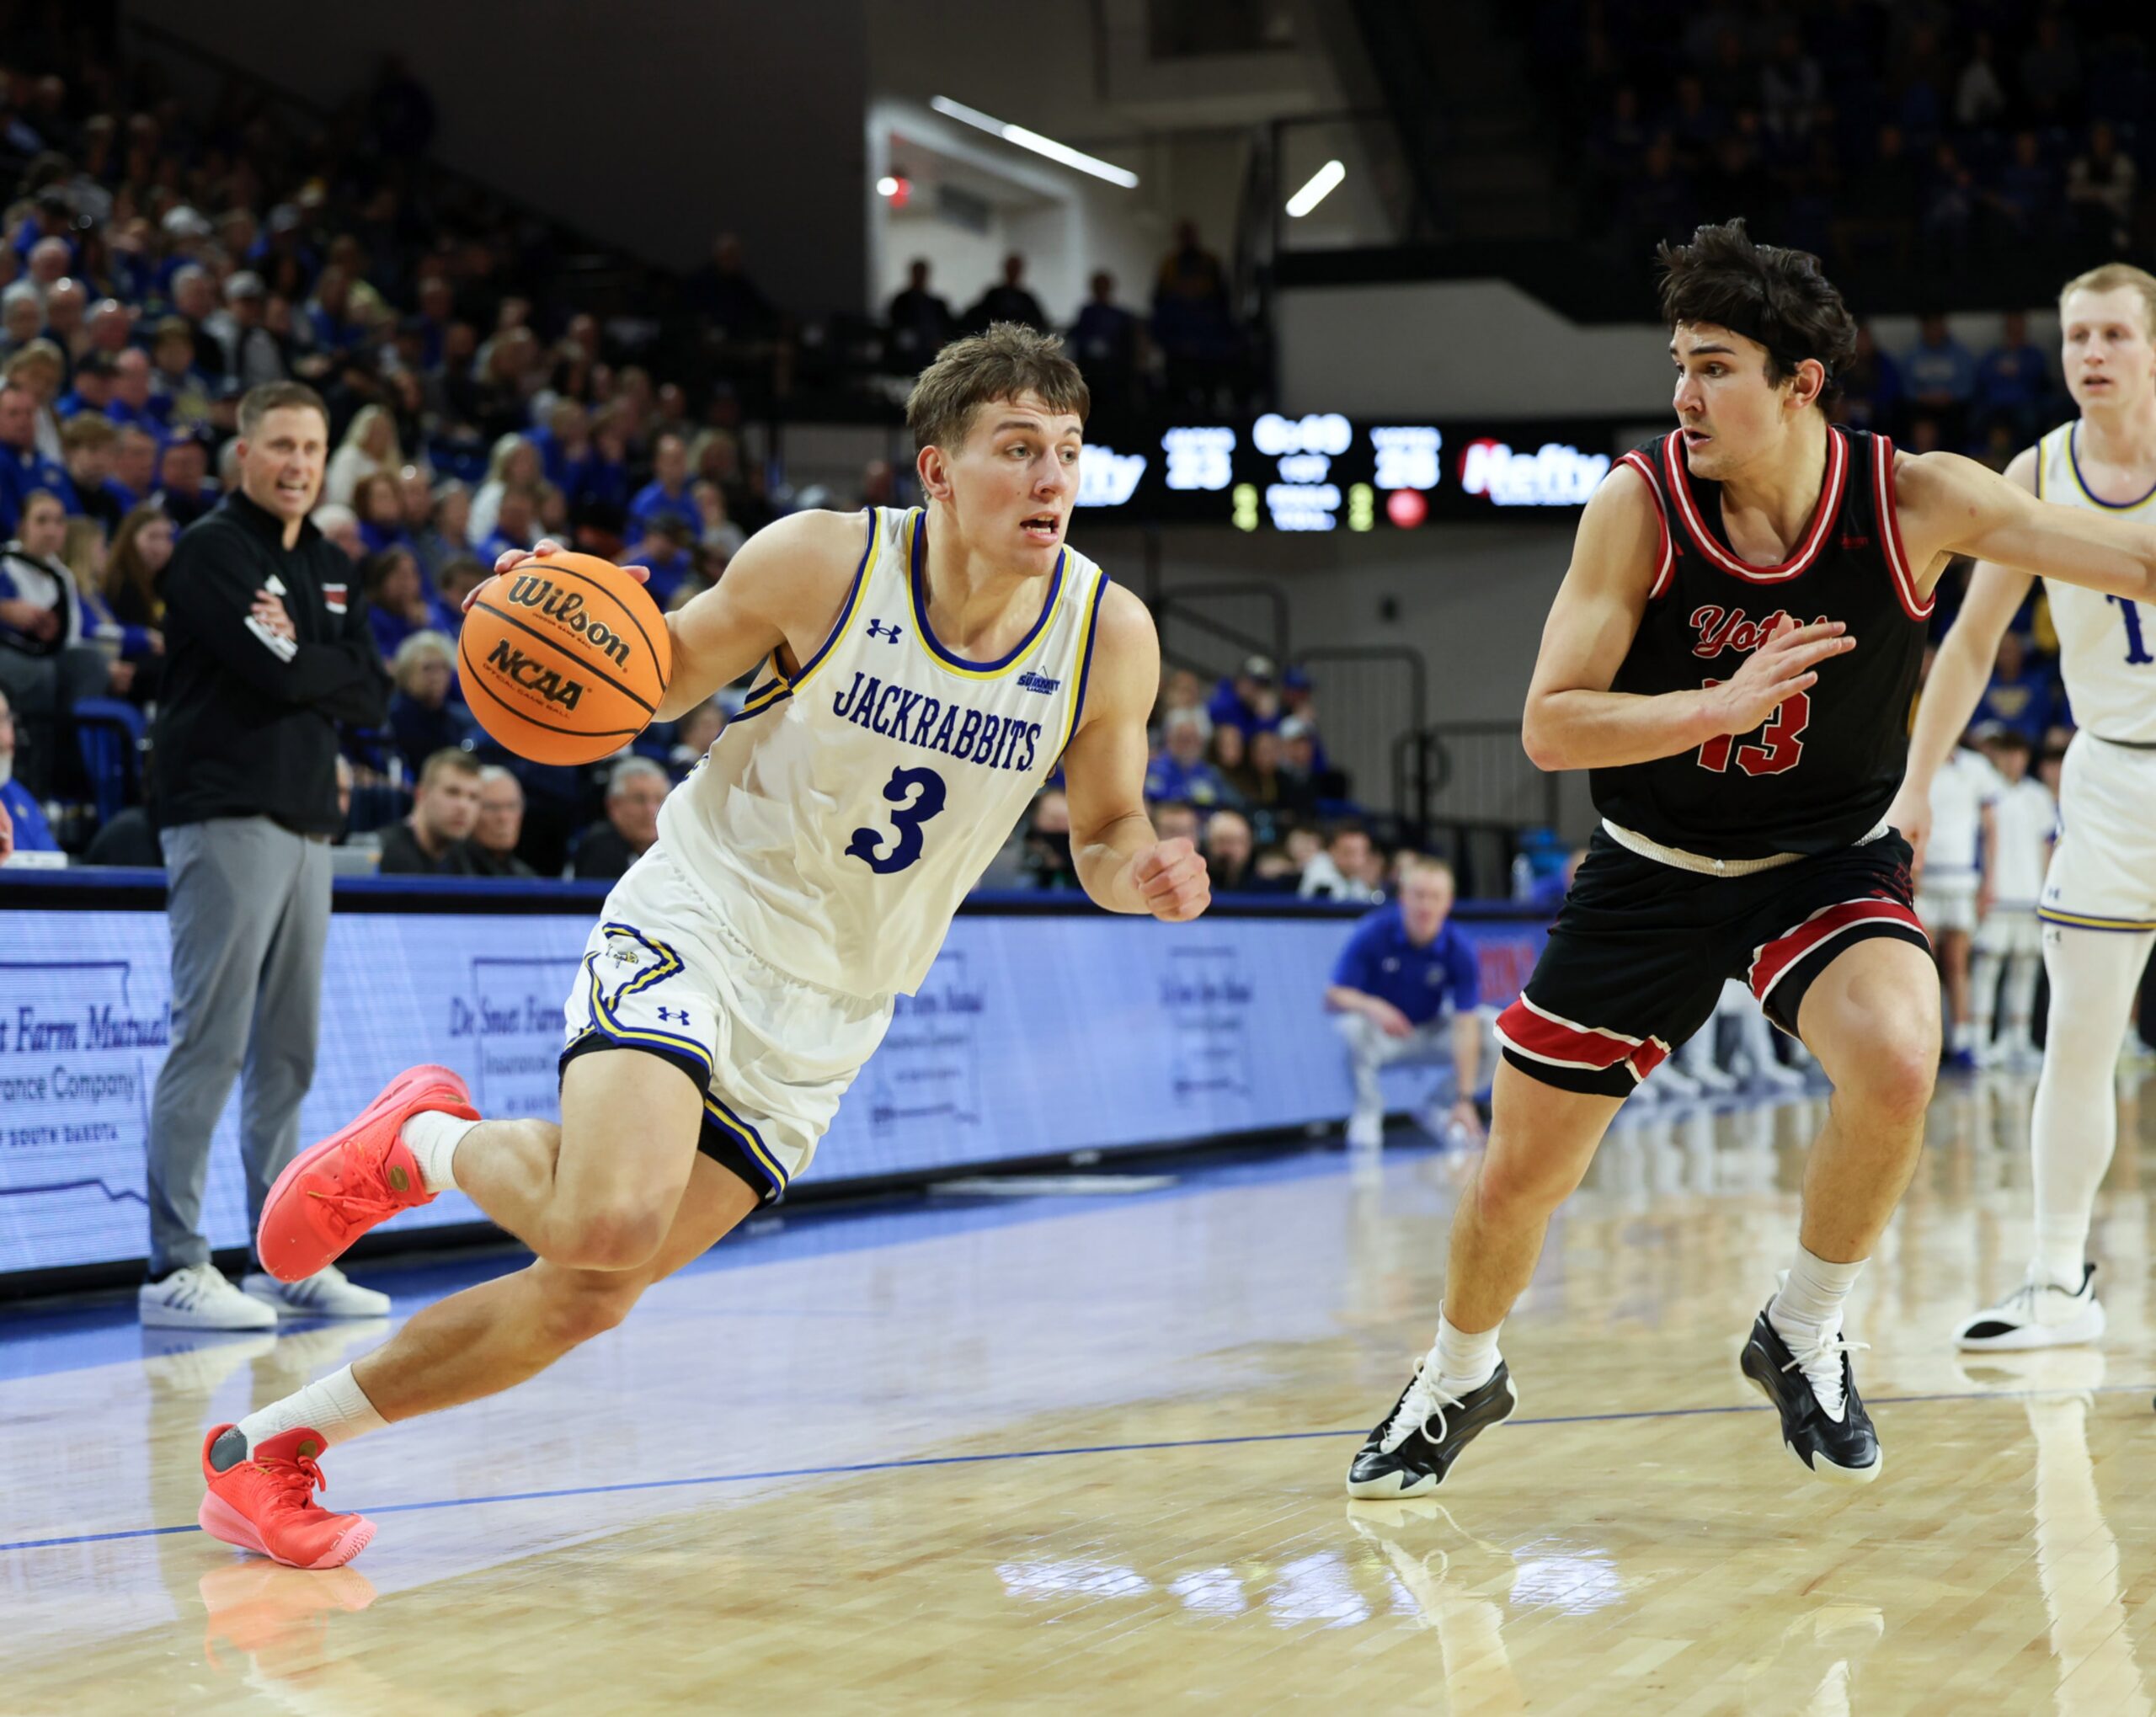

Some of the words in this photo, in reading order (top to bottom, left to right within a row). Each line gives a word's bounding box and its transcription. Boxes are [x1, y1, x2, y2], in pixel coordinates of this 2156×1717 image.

[507, 575, 631, 668] Wilson
[1689, 605, 1828, 659] Yot
[487, 638, 584, 712] NCAA
[517, 689, 544, 707] GAME
[546, 704, 571, 720] BALL
[832, 671, 1042, 772] JACKRABBITS
[844, 765, 947, 874] 3
[16, 1006, 77, 1052] Farm
[85, 1001, 170, 1049] Mutual
[52, 1065, 135, 1106] Company
